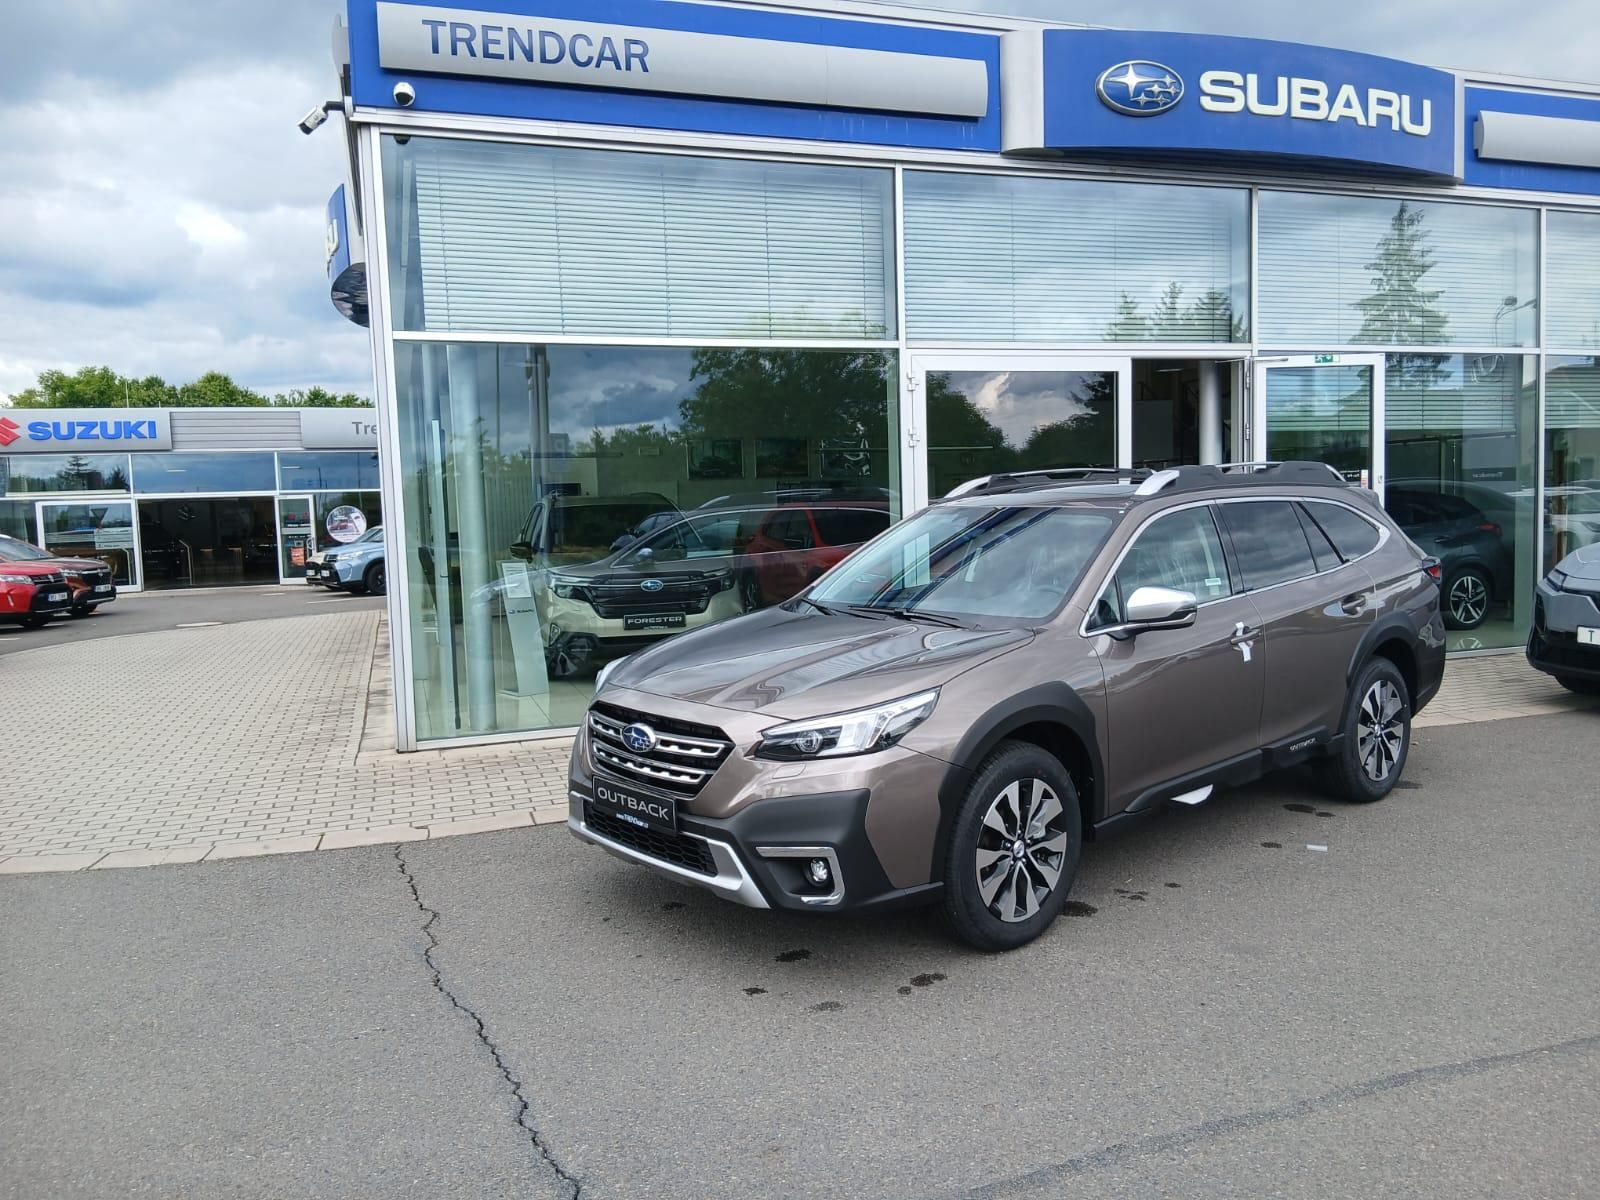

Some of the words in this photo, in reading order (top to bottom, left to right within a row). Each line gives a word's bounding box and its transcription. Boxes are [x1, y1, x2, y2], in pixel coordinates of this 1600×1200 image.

[422, 19, 650, 73] TRENDCAR
[1199, 70, 1432, 137] SUBARU
[27, 420, 157, 441] SUZUKI
[627, 616, 682, 625] FORESTER
[597, 787, 670, 821] OUTBACK
